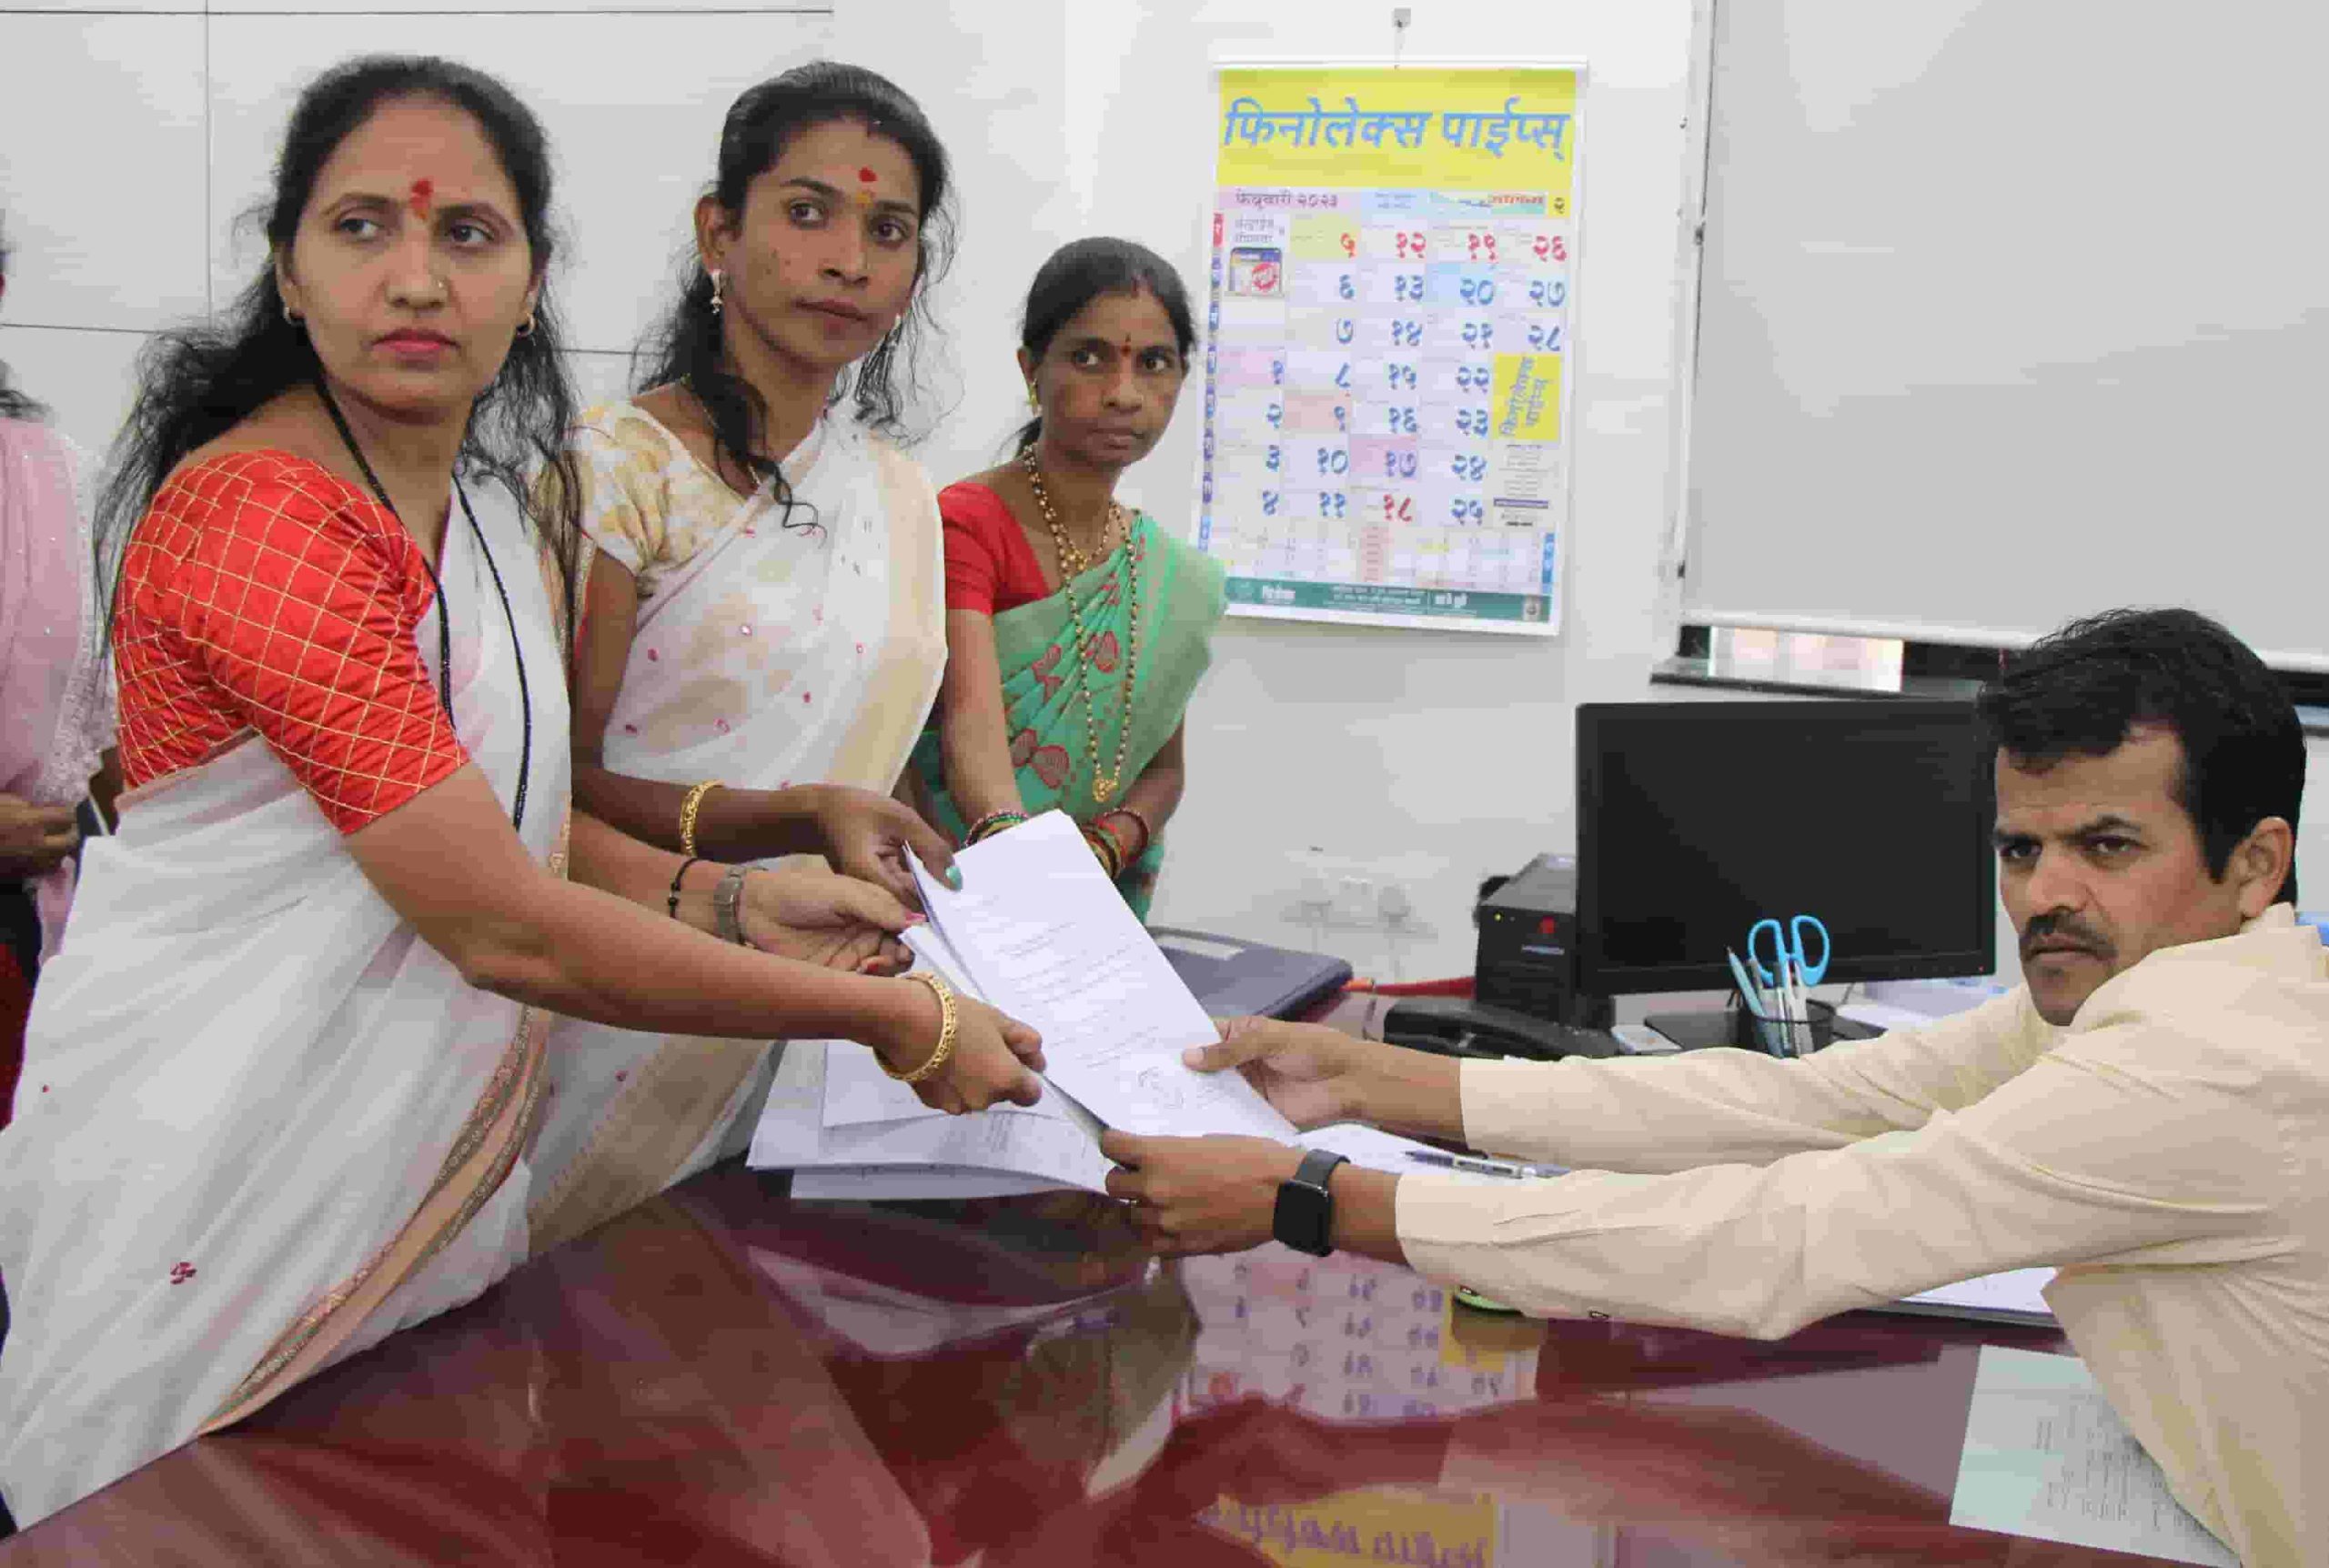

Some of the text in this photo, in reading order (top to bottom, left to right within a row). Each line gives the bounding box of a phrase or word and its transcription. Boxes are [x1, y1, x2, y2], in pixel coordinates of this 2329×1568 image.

[1224, 96, 1572, 160] फिनोलेक्स पाईप्स्
[1296, 193, 1339, 210] २०२३
[1396, 232, 1427, 258] १२
[1533, 236, 1567, 262] २६
[1339, 275, 1565, 307] ६ १३ २० २७
[1336, 319, 1354, 345] ७
[1392, 320, 1422, 347] १४
[1528, 325, 1565, 351] २८
[1335, 363, 1351, 388] ८
[1317, 448, 1351, 475] १०
[1386, 450, 1417, 477] १७
[1451, 455, 1487, 481] २४
[1319, 492, 1346, 518] ११
[1384, 494, 1412, 522] १८
[1451, 499, 1485, 526] २५
